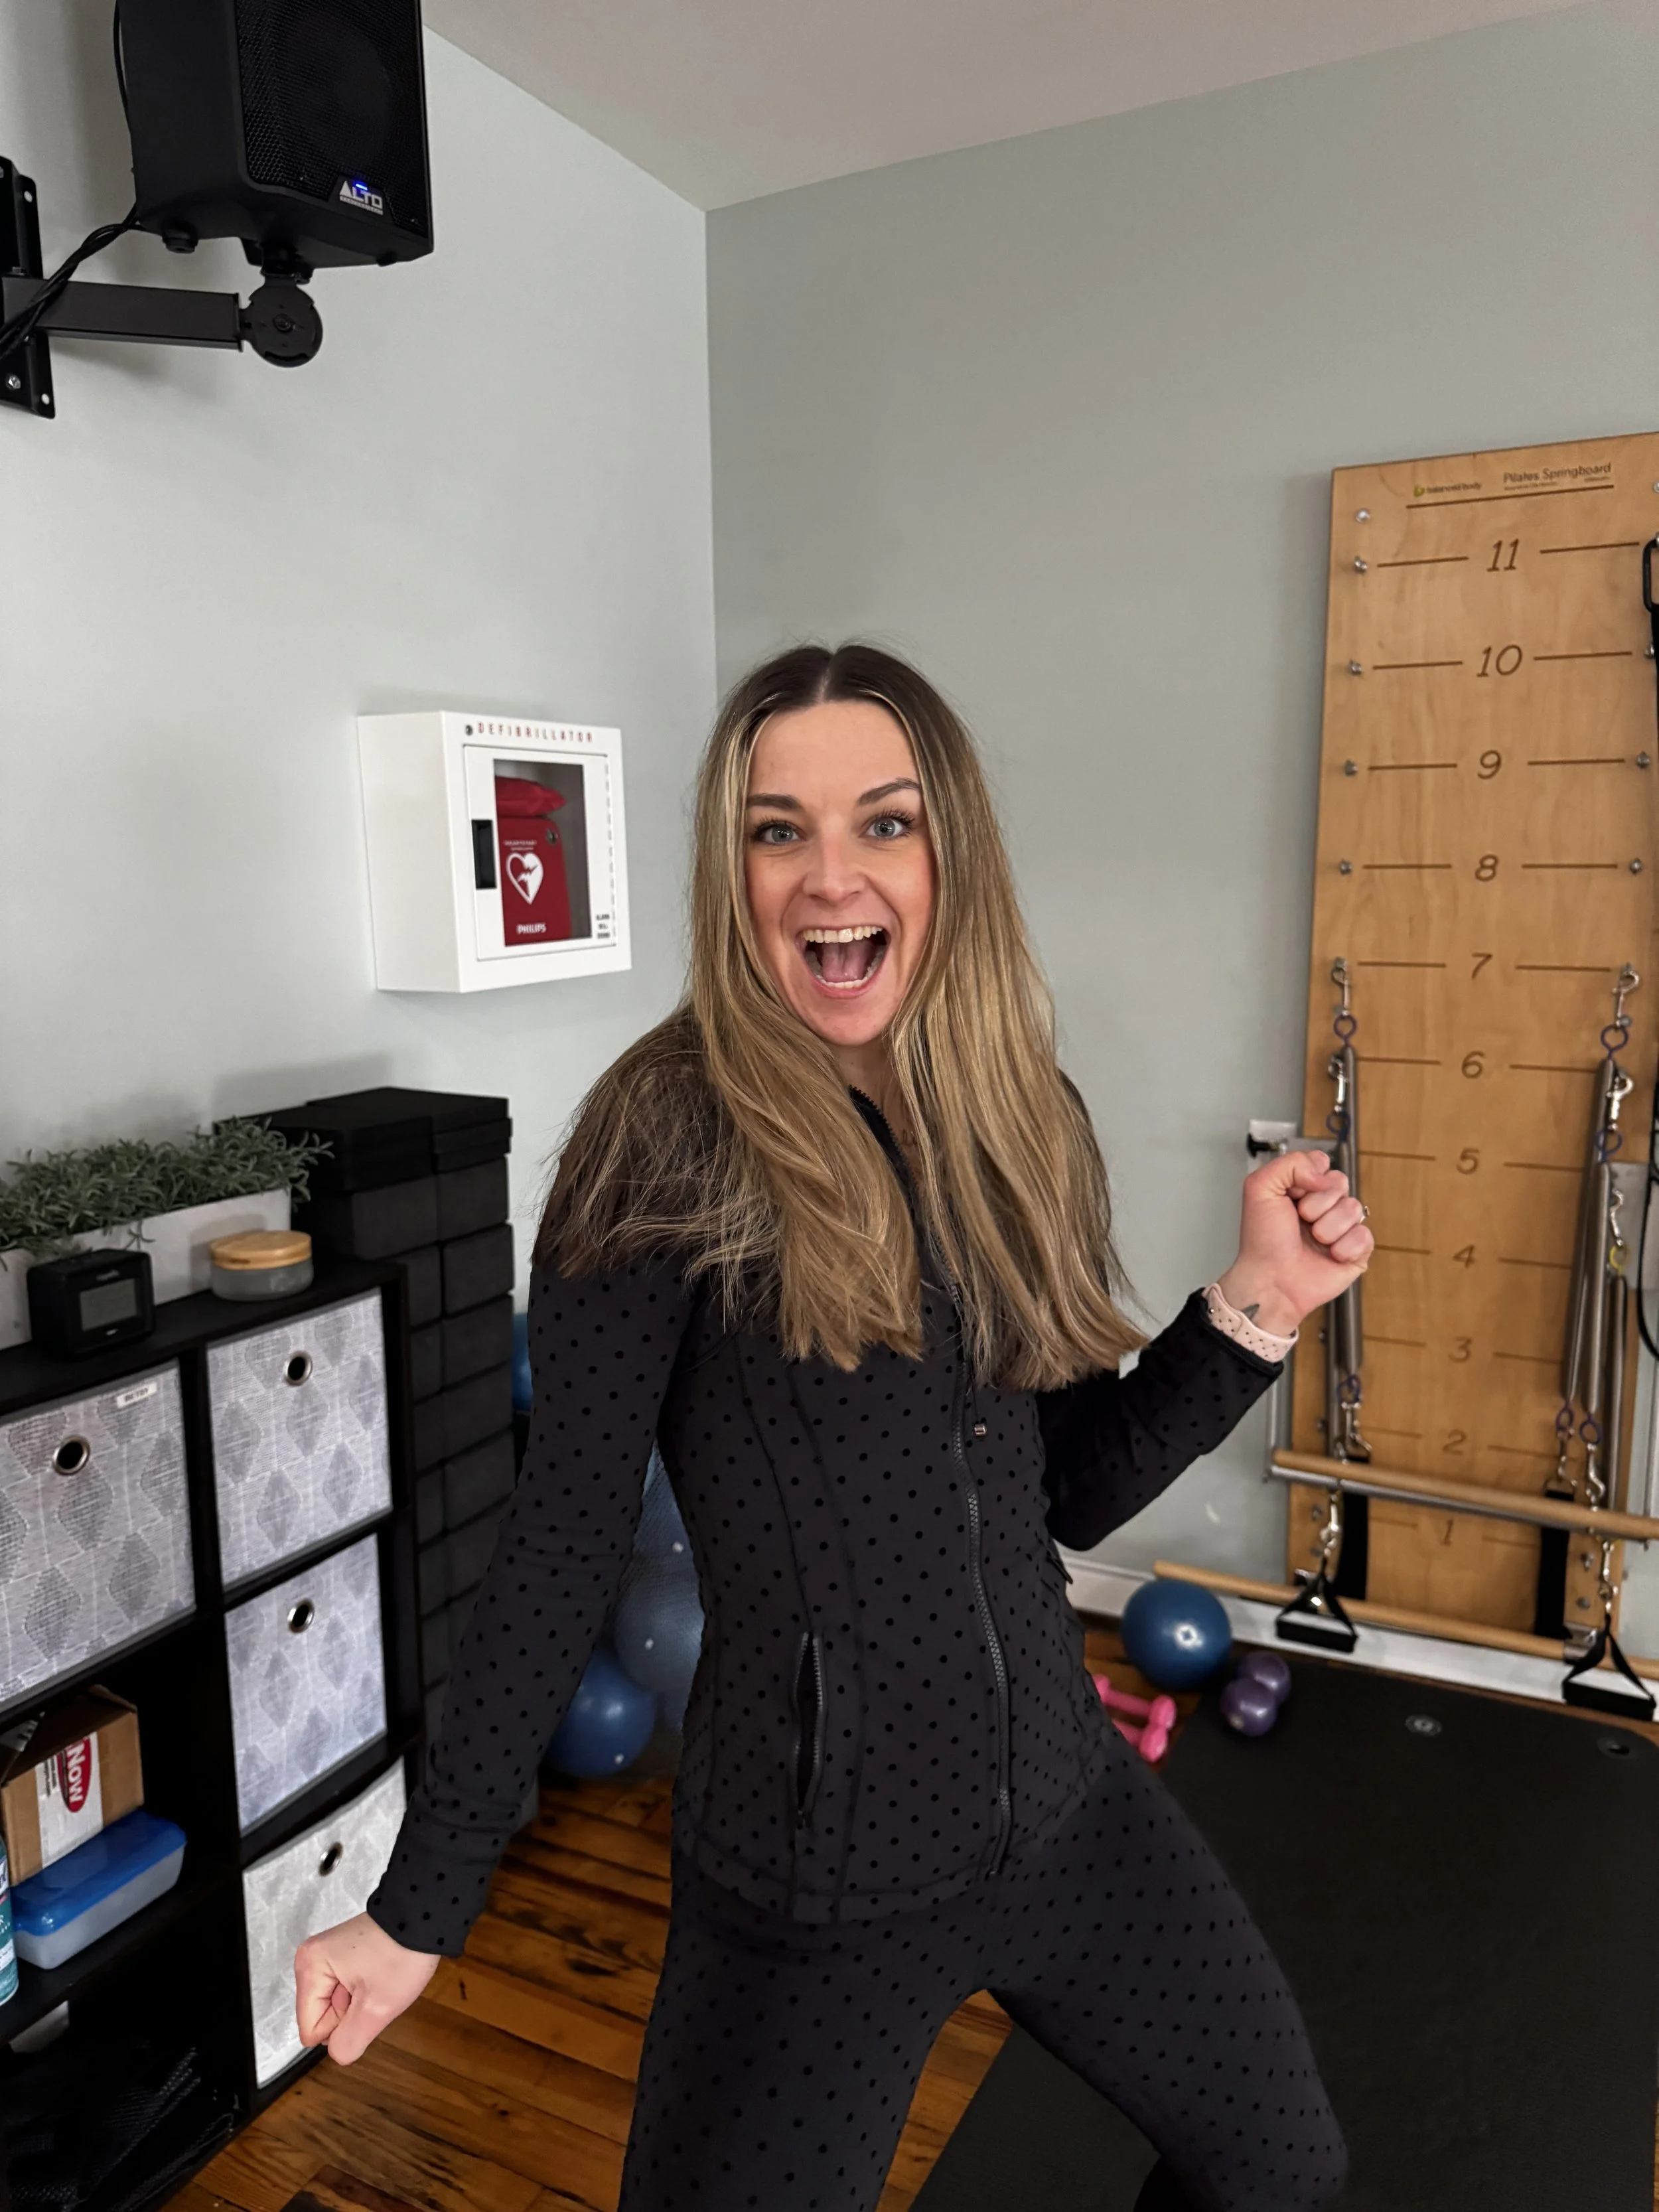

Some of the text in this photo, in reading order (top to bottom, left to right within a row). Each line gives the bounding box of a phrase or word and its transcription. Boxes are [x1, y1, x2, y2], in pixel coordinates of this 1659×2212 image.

[340, 181, 383, 209] ALTO
[1503, 471, 1539, 483] Pilates
[1543, 463, 1611, 481] Springboard
[1486, 538, 1520, 572] 11
[1477, 644, 1523, 678] 10
[477, 721, 593, 743] DEFIBRILLATOR
[1477, 749, 1502, 780] 9
[1475, 854, 1499, 882] 8
[516, 923, 546, 934] PHILIPS
[1471, 952, 1492, 980] 7
[1461, 1051, 1485, 1079] 6
[1456, 1148, 1480, 1175] 5
[1453, 1244, 1475, 1268] 4
[1448, 1336, 1473, 1363] 3
[1442, 1428, 1467, 1455] 2
[1440, 1518, 1455, 1546] 1
